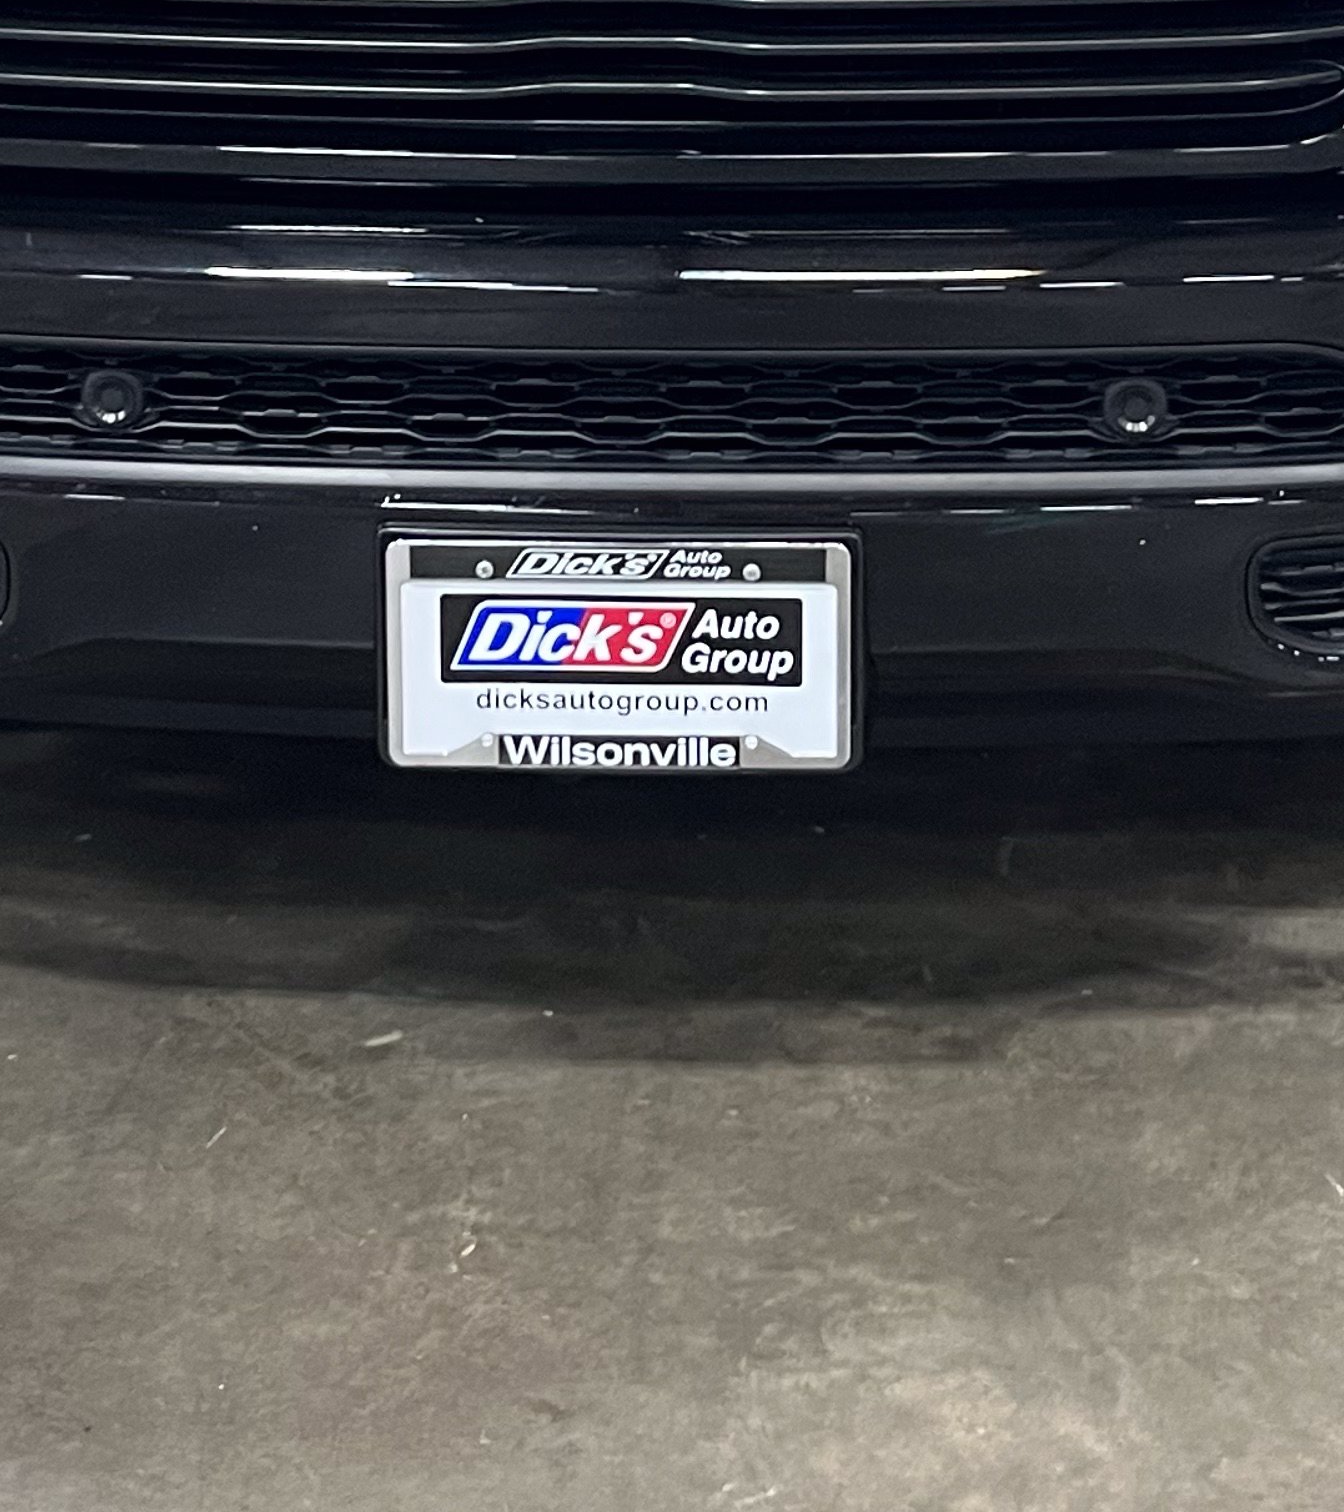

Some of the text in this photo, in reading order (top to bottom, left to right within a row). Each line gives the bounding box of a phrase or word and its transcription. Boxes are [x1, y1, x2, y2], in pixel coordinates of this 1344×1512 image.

[517, 552, 651, 576] Dick's
[663, 562, 732, 580] Group
[669, 549, 724, 565] Auto
[467, 610, 664, 664] Dick's
[691, 608, 781, 640] Auto
[680, 642, 794, 682] Group
[475, 689, 769, 717] dicksautogroup.com
[503, 734, 737, 768] Wilsonville
